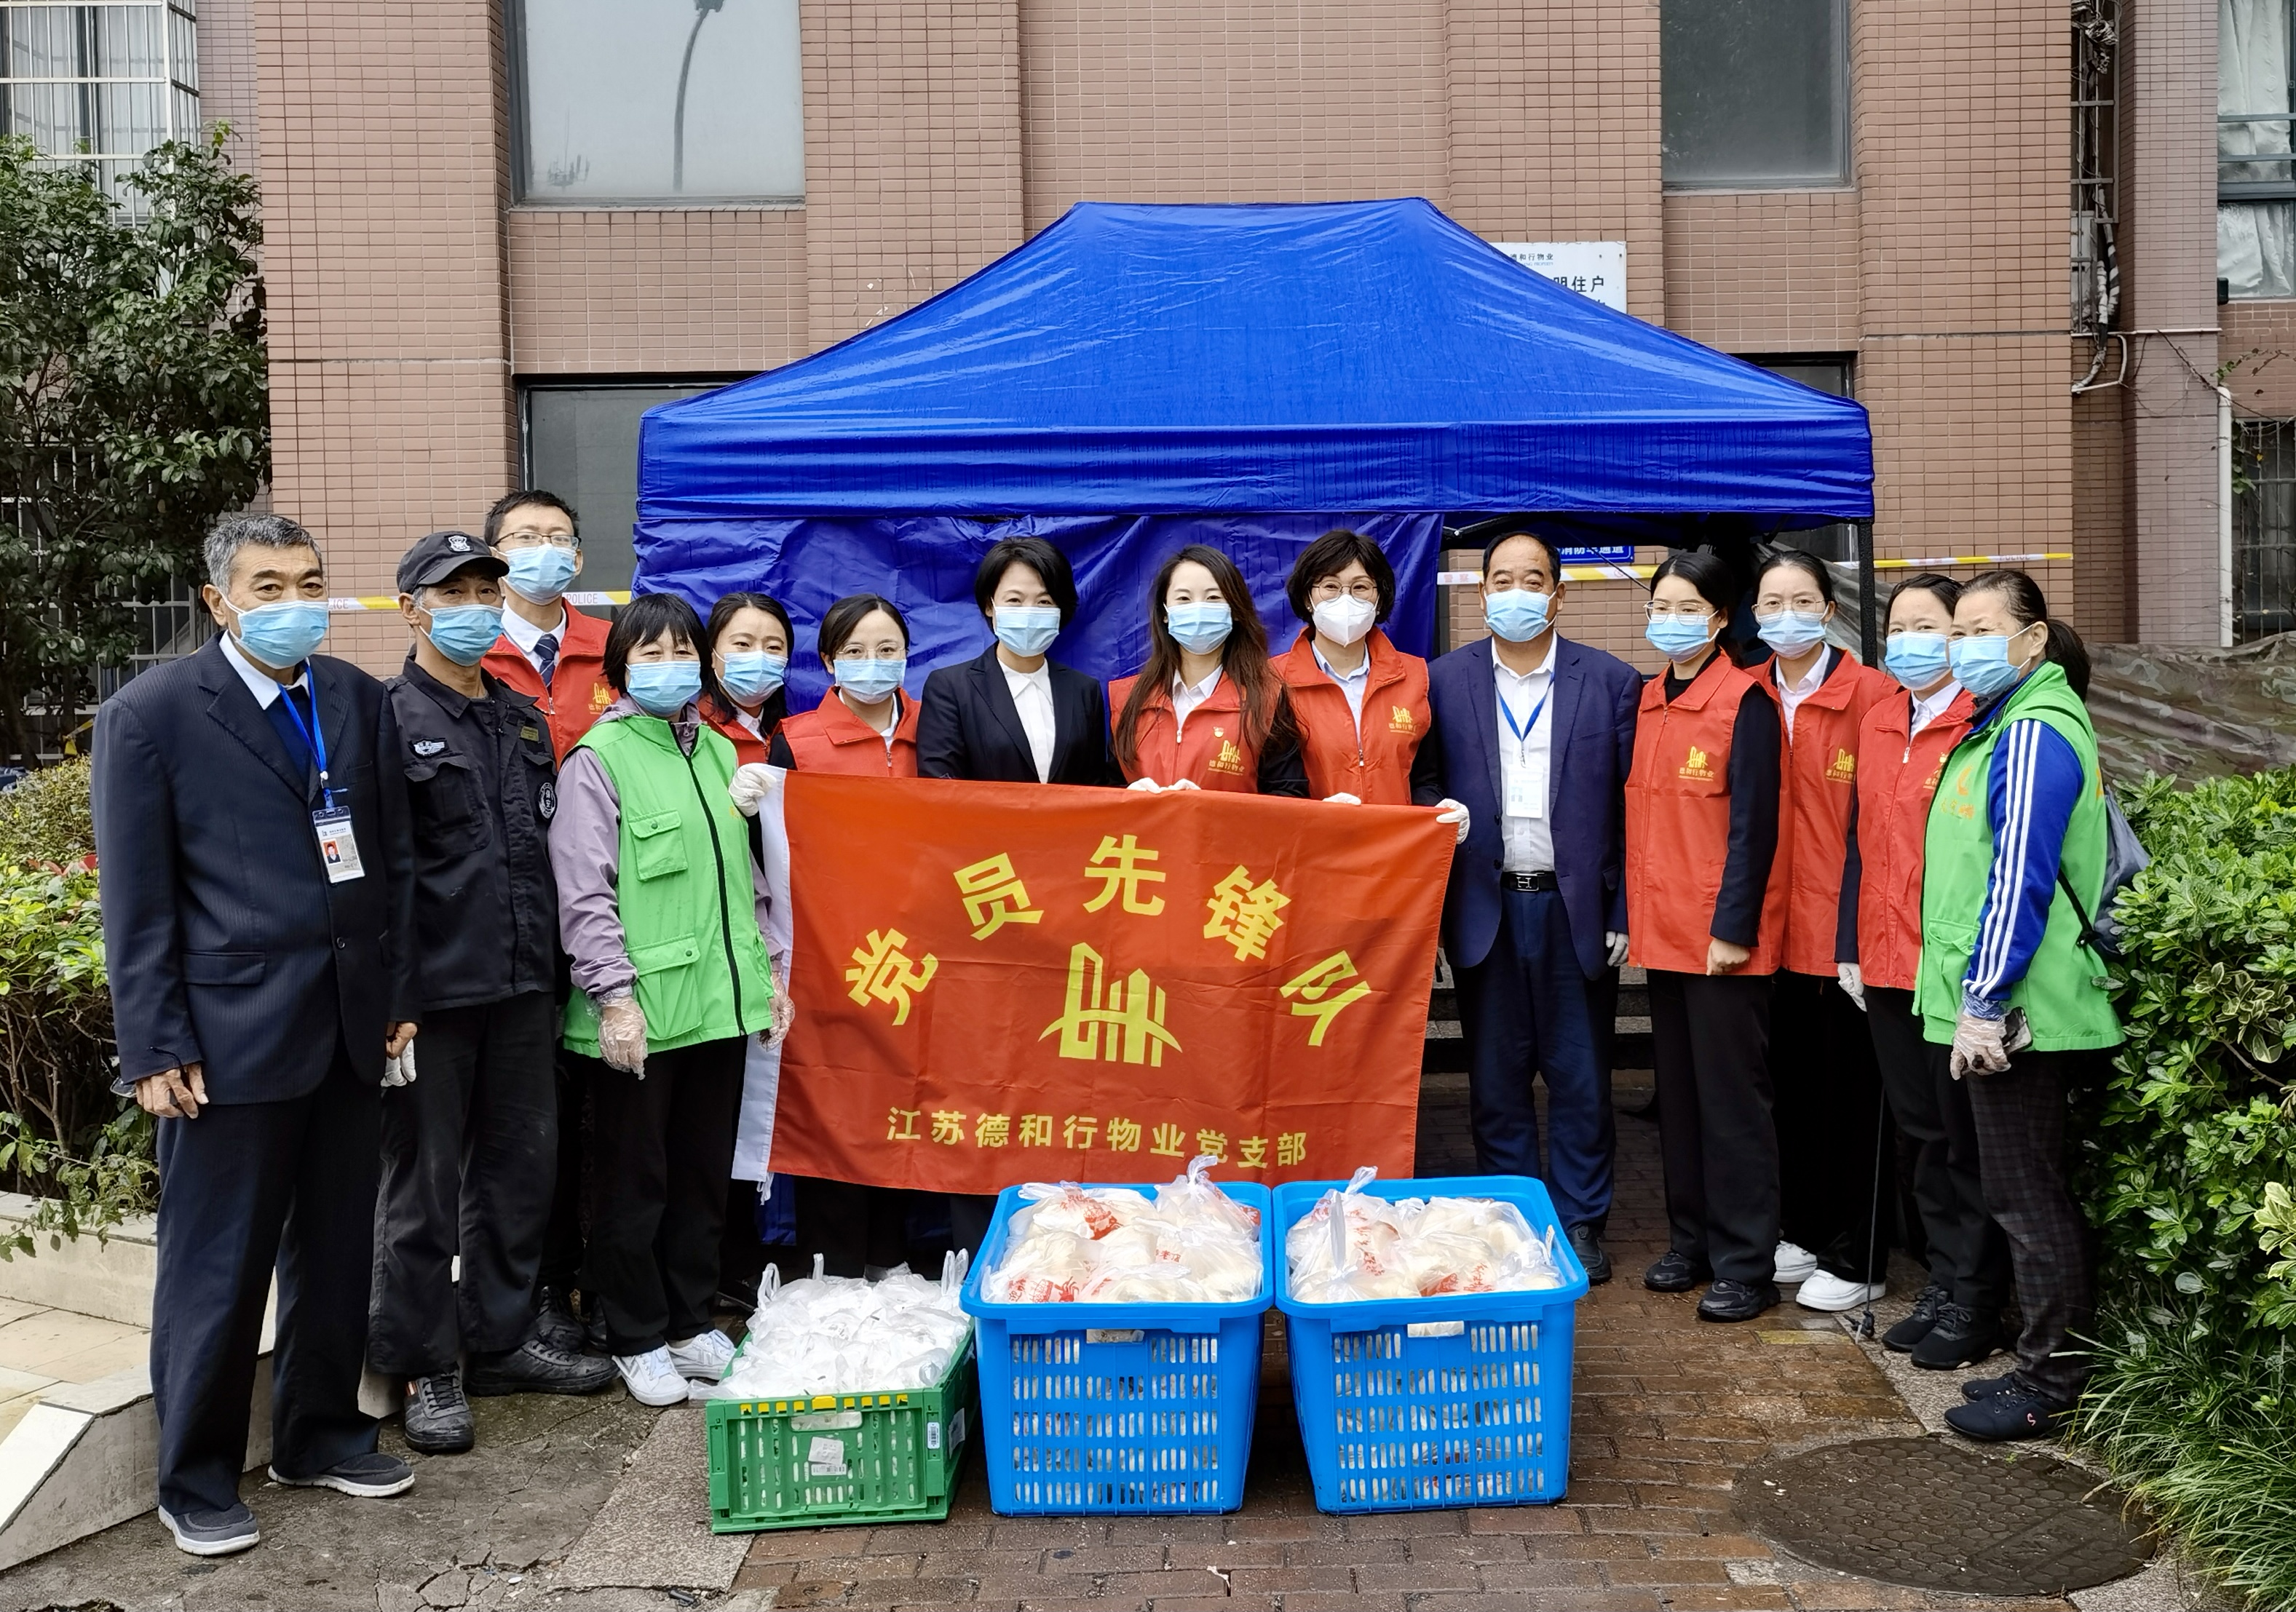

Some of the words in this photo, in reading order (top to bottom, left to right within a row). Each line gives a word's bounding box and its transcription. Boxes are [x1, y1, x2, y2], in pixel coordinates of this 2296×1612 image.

[566, 593, 598, 604] POLICE
[845, 834, 1373, 1047] 党员先锋队
[886, 1106, 1307, 1169] 江苏德和行物业党支部
